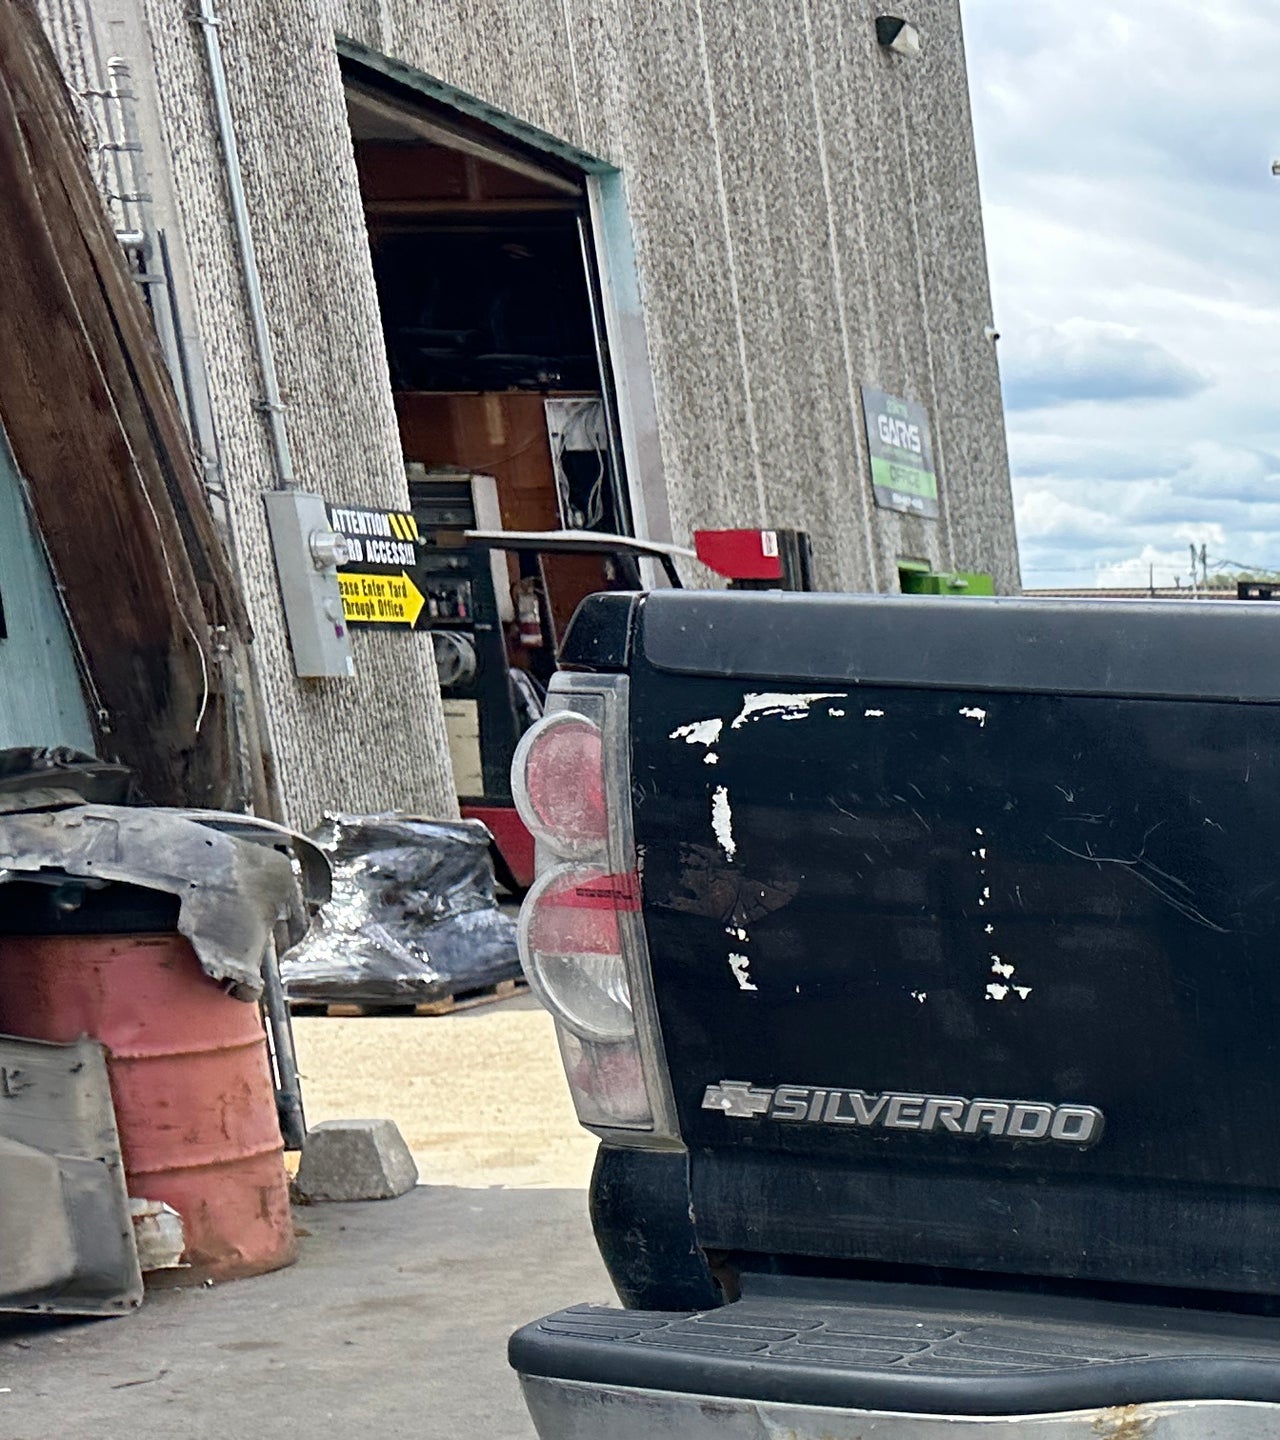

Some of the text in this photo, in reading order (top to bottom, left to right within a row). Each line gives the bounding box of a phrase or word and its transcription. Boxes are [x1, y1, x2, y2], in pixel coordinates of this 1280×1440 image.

[331, 508, 392, 537] ATTENTION
[345, 538, 417, 566] RD ACCESS!!!
[339, 578, 408, 599] ease Enter Yard
[378, 599, 405, 618] Office
[771, 1086, 1101, 1142] SILVERADO
